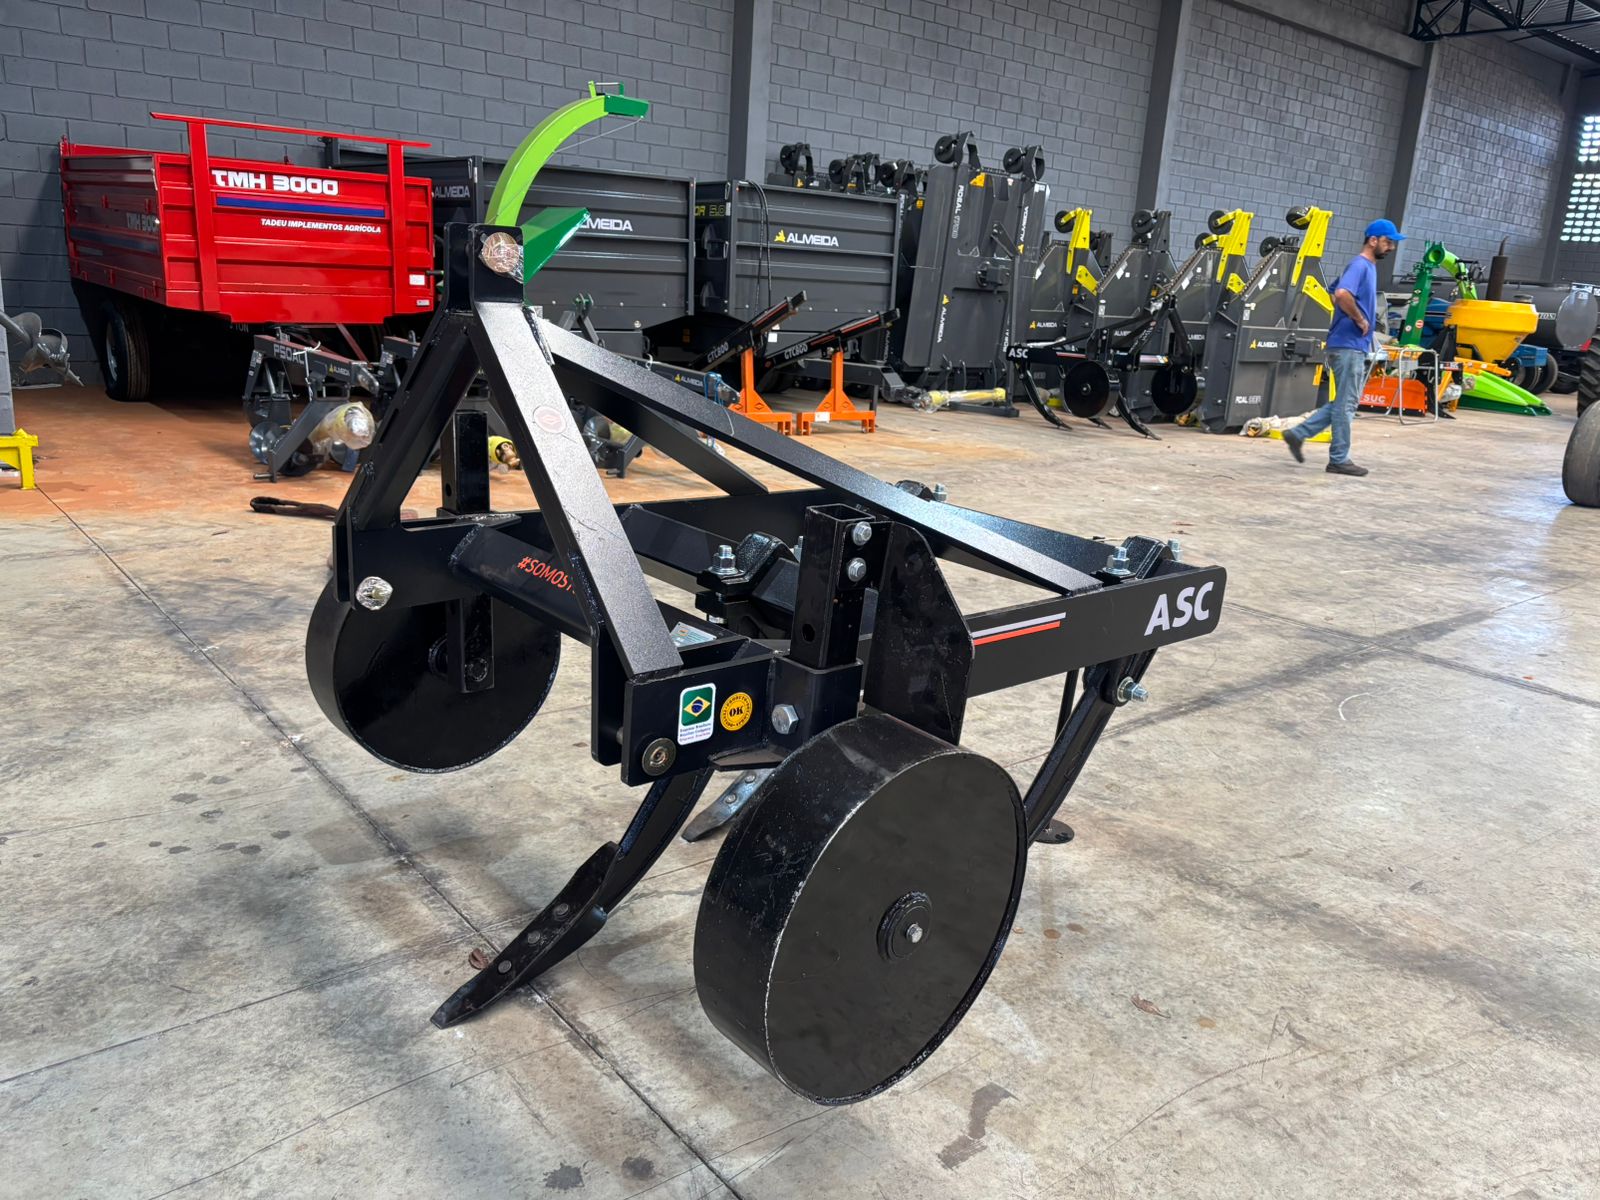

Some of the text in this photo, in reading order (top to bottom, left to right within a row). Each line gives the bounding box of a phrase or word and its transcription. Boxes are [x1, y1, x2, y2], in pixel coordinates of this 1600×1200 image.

[211, 169, 339, 196] TMH 3000
[261, 218, 381, 233] TADEU IMPLEMENTOS AGRÍCOLA
[786, 232, 839, 247] ALMEIDA
[1008, 347, 1029, 359] ASC
[1143, 581, 1214, 637] ASC
[729, 706, 743, 717] OK
